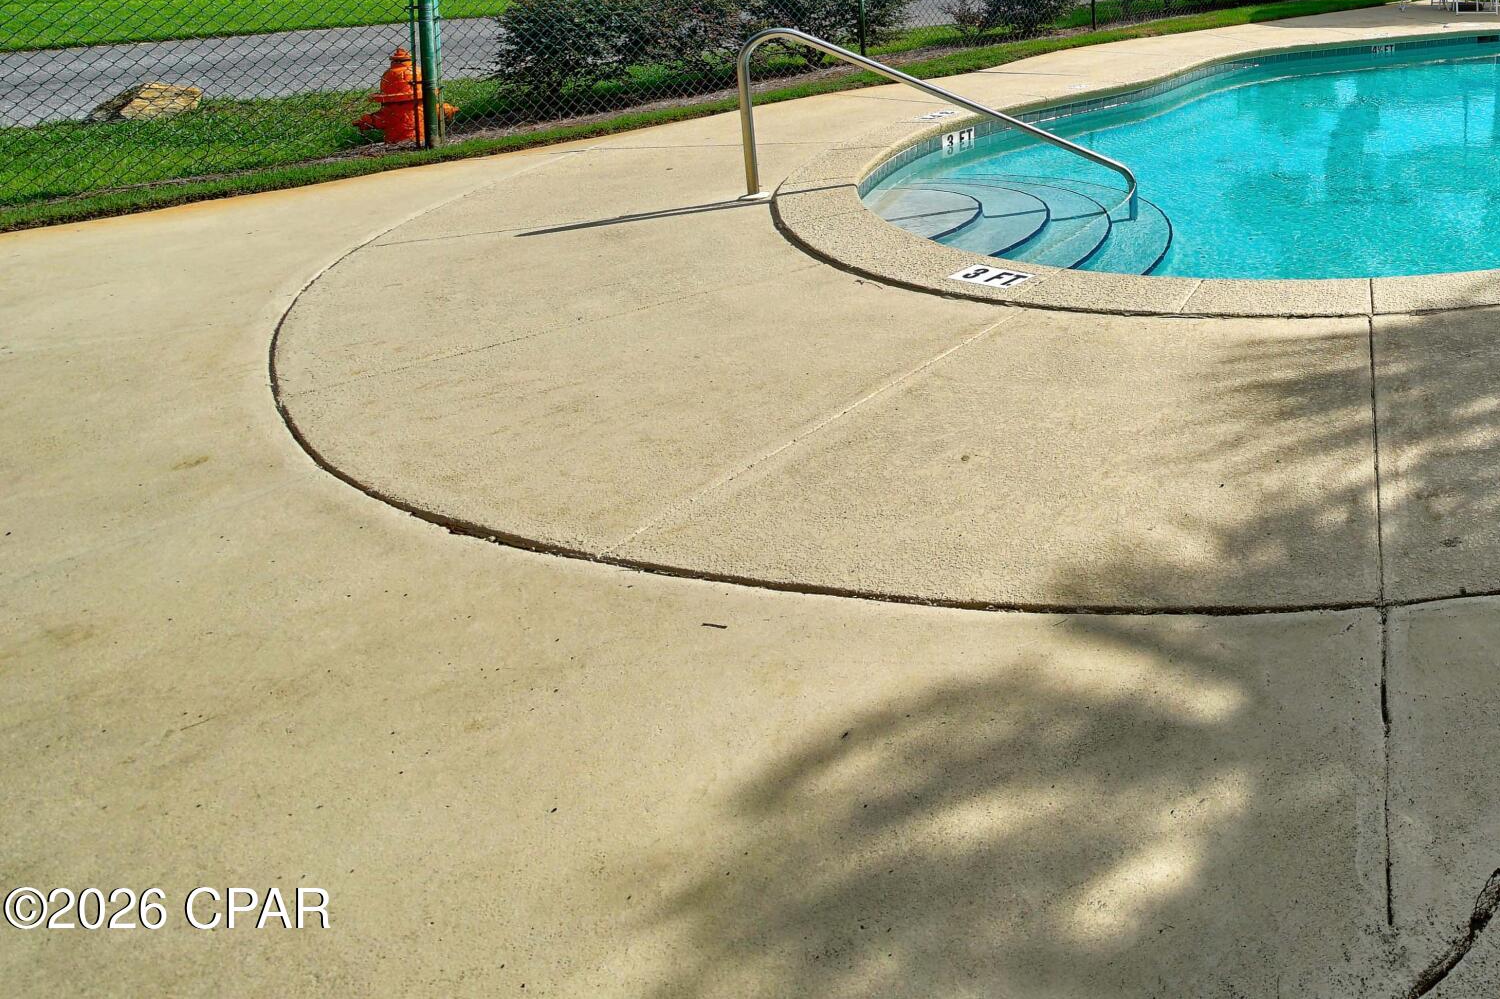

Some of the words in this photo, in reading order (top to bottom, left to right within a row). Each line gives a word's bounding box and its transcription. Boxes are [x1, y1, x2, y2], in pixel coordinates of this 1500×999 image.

[946, 134, 954, 147] 3
[959, 128, 973, 144] FT
[962, 268, 990, 279] 3
